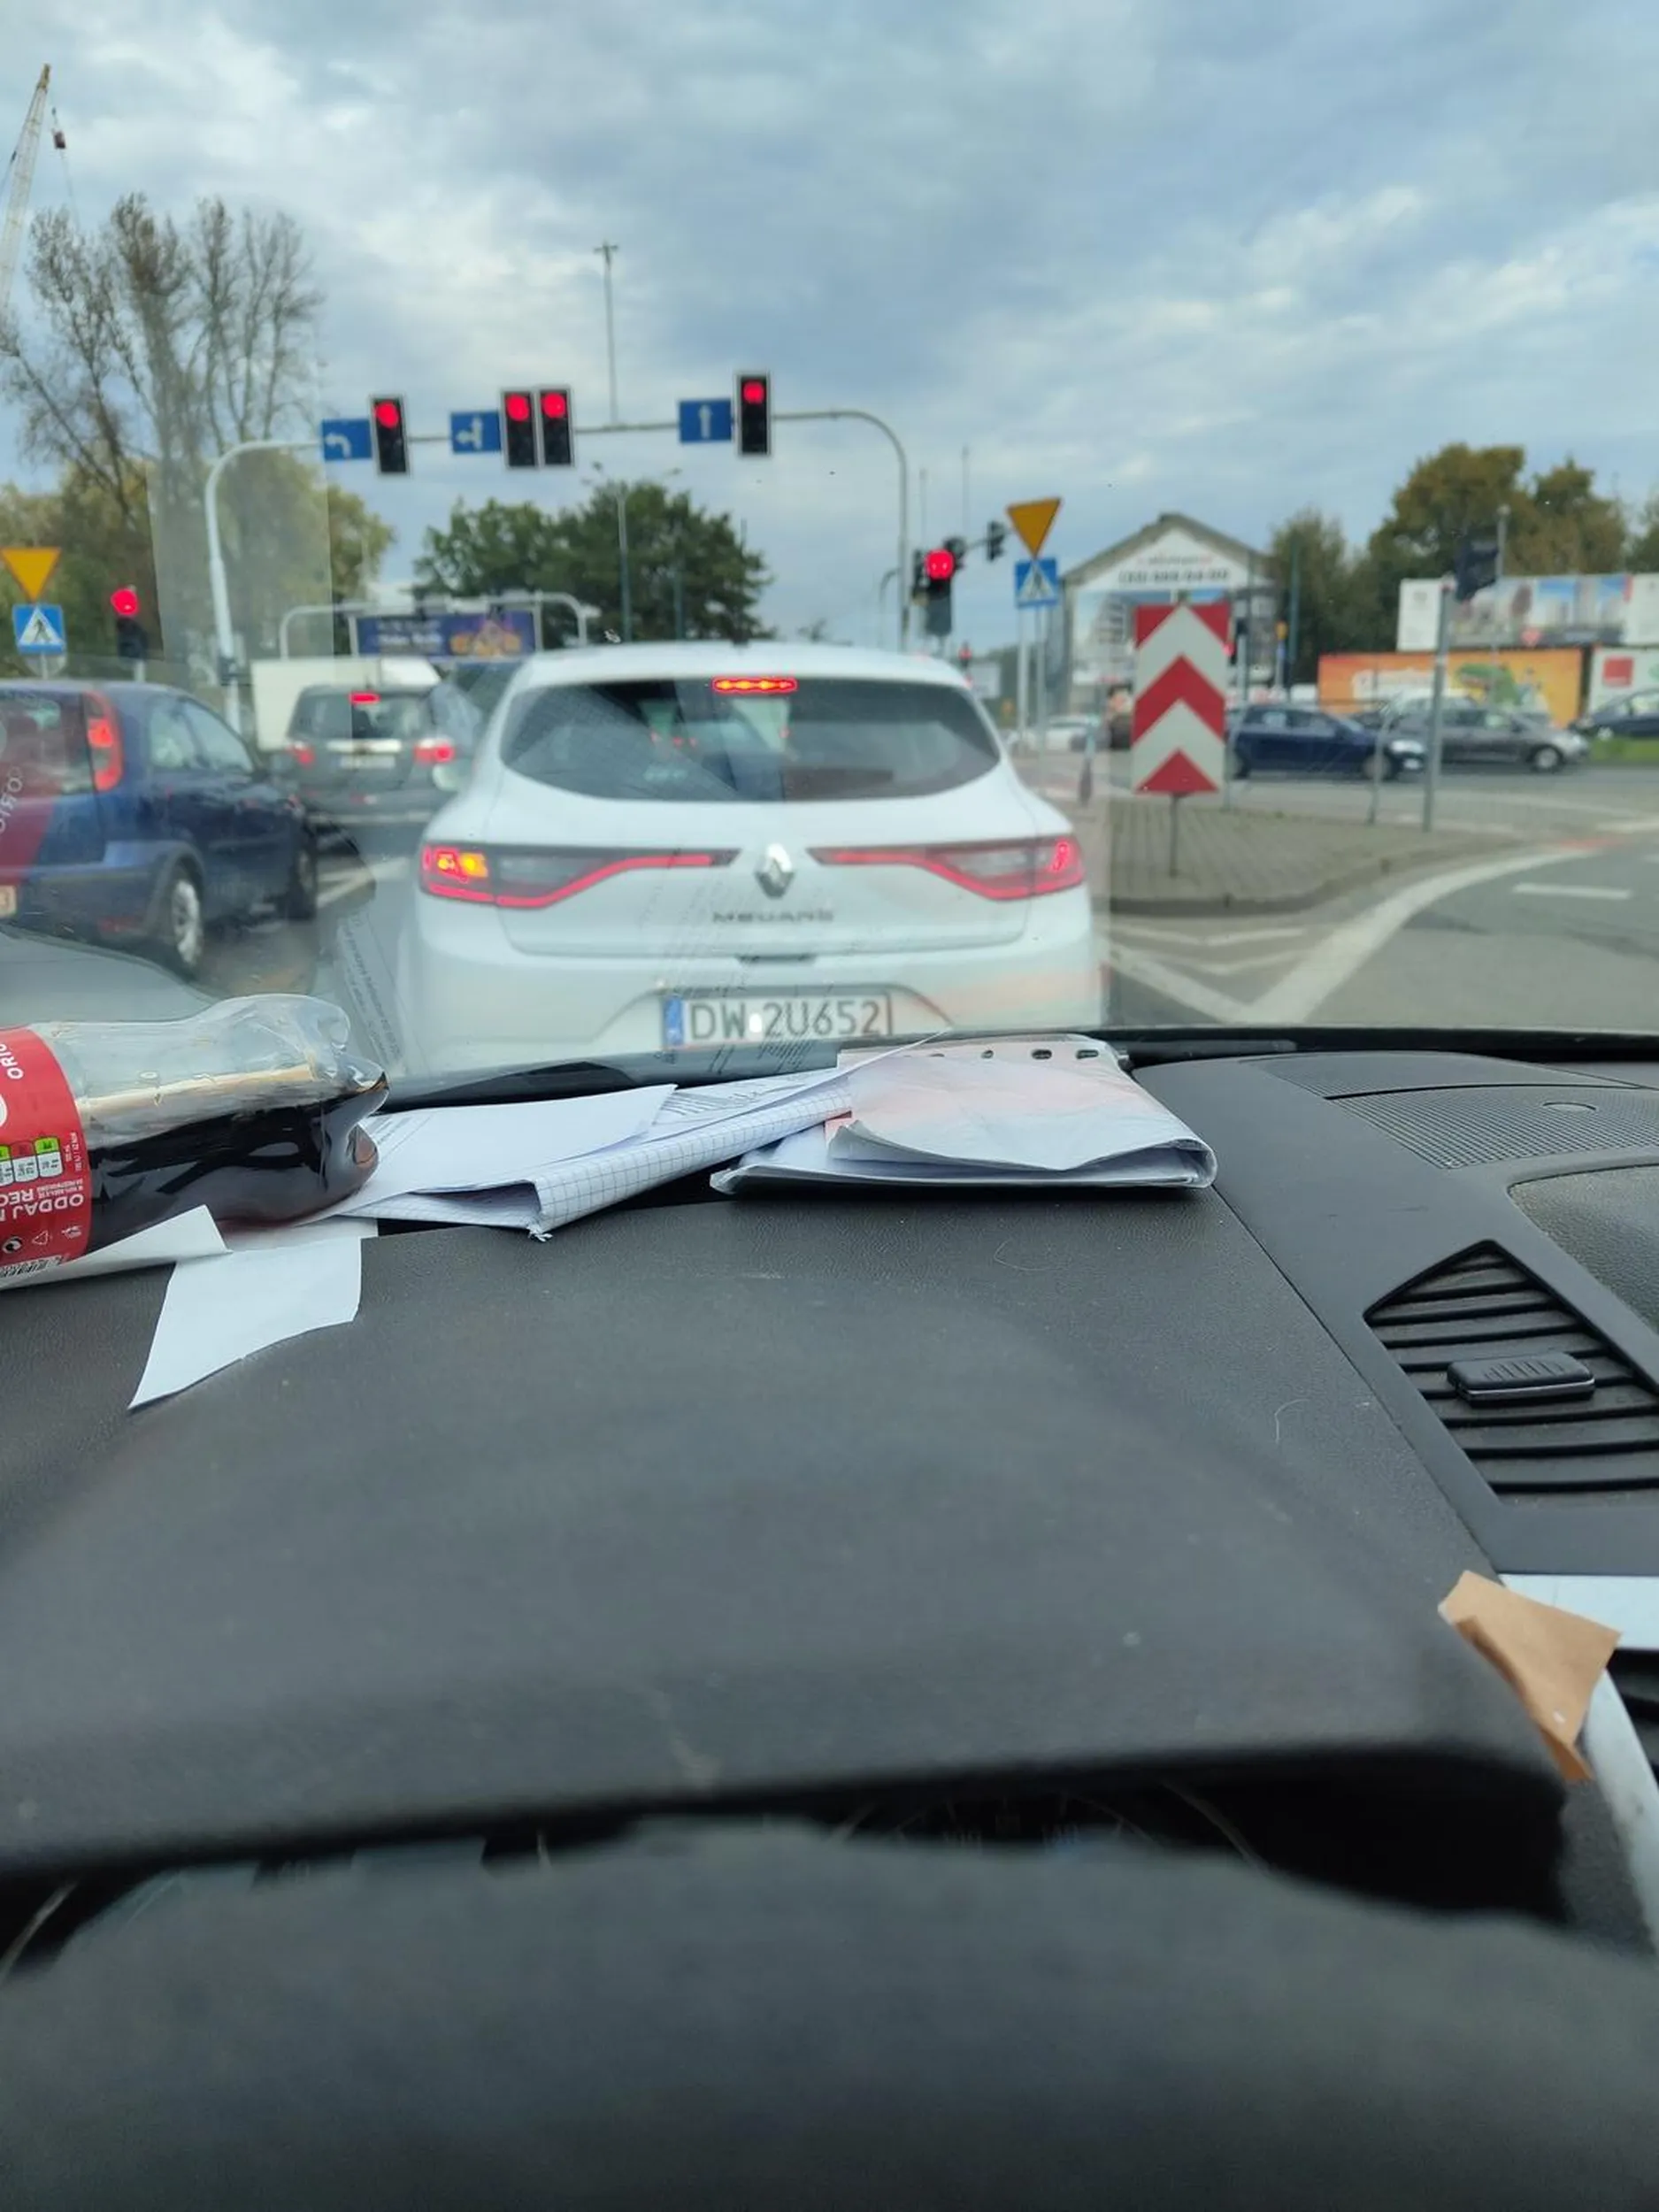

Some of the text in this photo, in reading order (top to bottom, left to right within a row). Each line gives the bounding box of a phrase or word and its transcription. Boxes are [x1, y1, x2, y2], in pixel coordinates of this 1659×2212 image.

[690, 1000, 881, 1040] DW 2U652
[12, 1193, 84, 1219] ODDAJ
